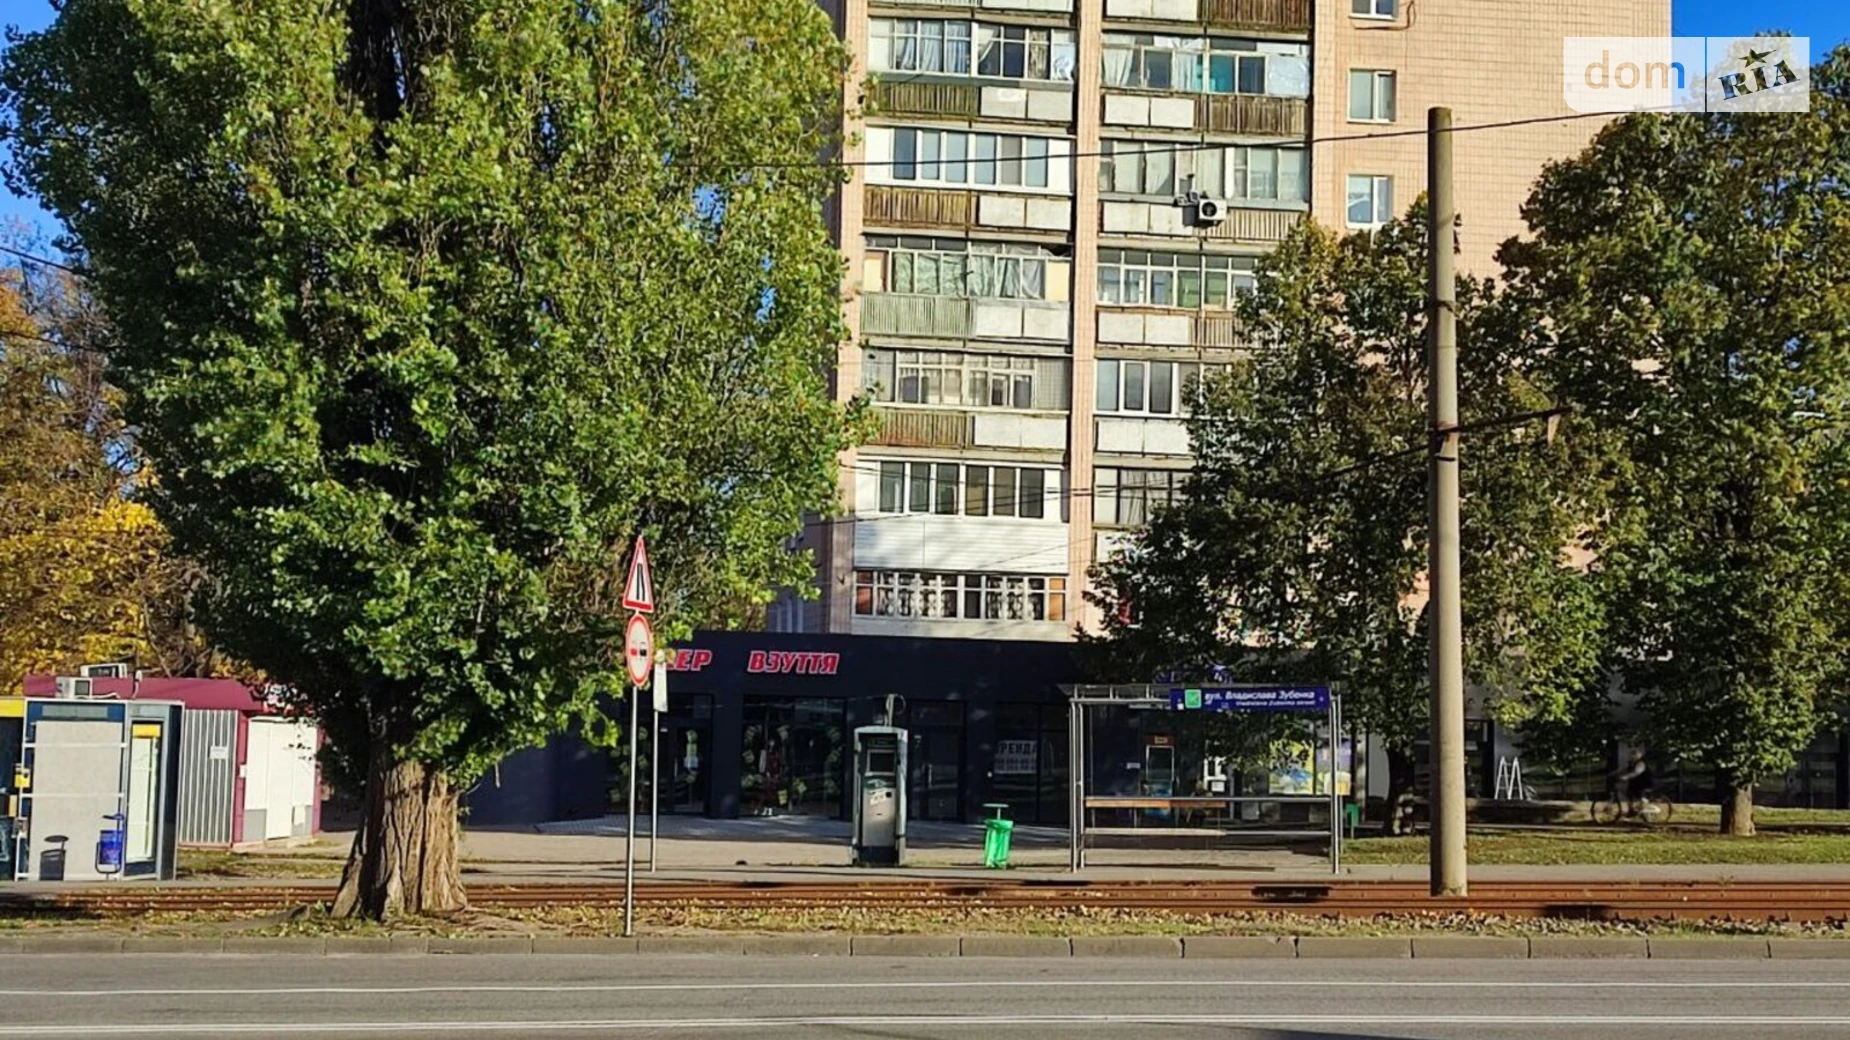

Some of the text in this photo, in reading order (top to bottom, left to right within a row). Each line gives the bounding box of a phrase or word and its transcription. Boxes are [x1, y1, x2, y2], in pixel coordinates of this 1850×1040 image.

[666, 648, 840, 675] ЕР ВЗУТТЯ
[1204, 693, 1223, 705] вул.
[1225, 690, 1276, 700] Владислава
